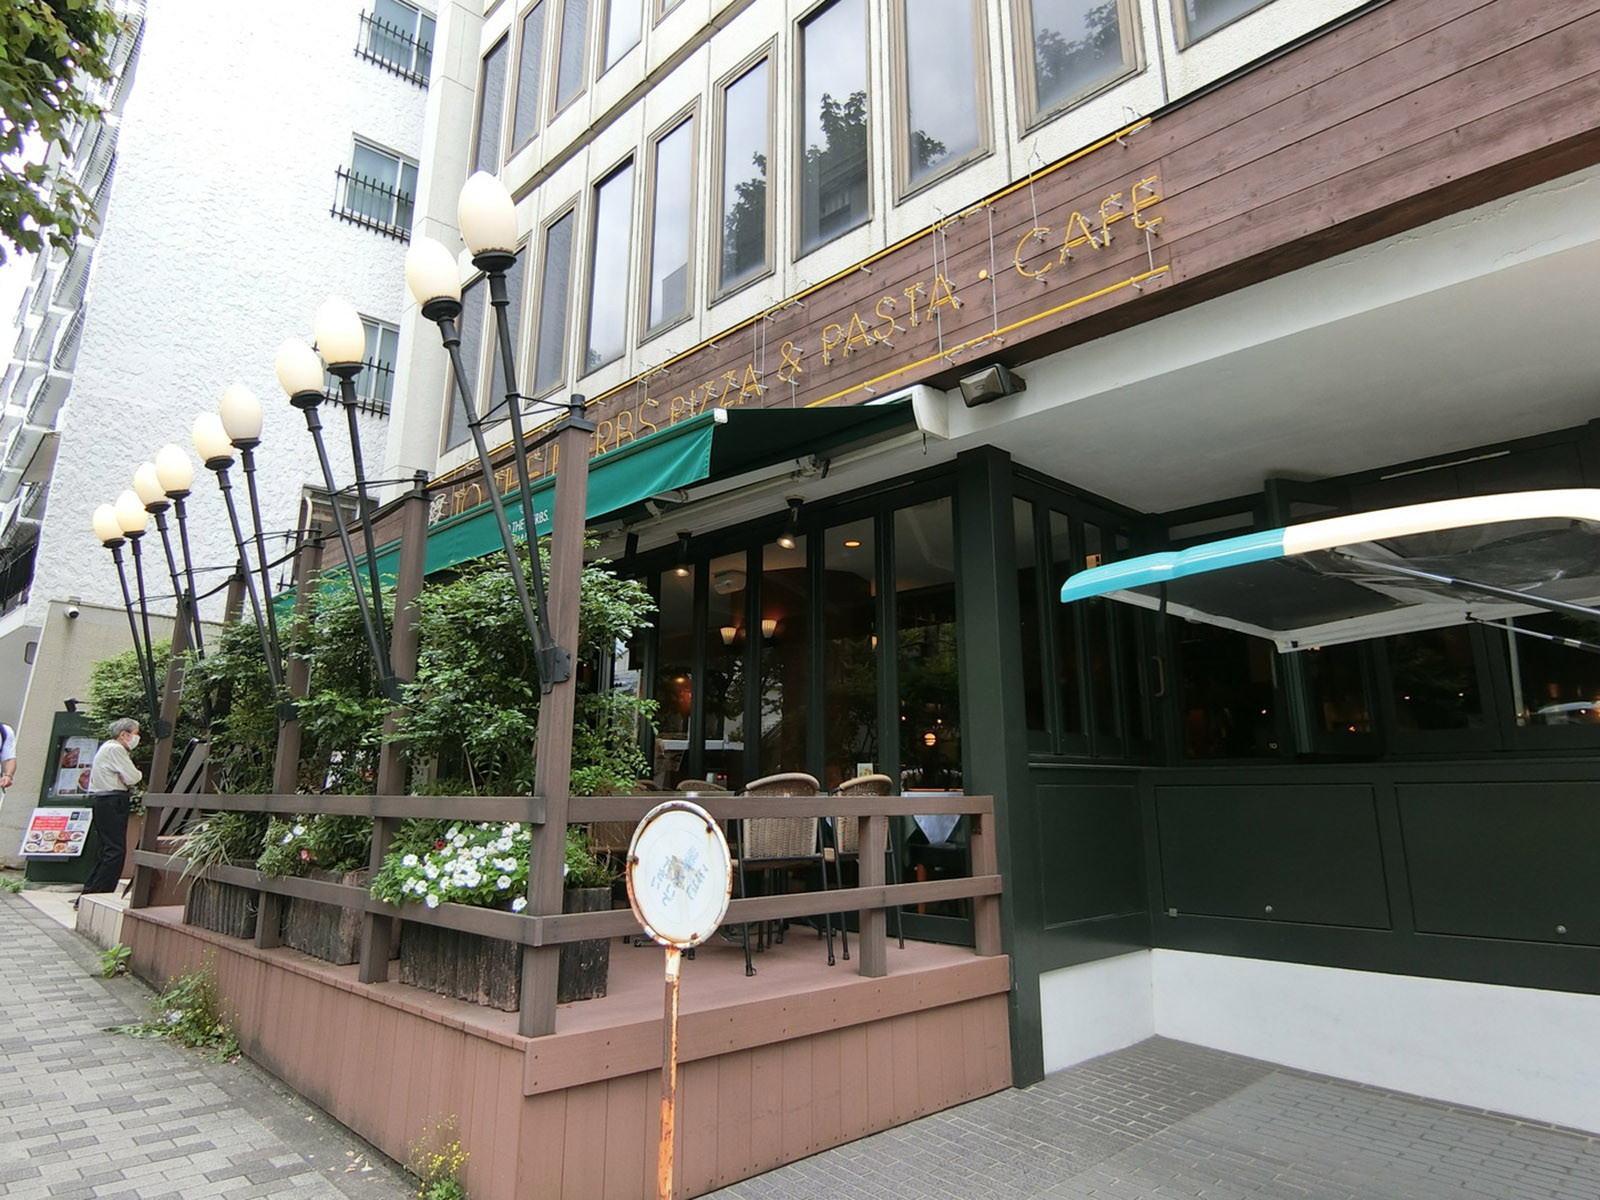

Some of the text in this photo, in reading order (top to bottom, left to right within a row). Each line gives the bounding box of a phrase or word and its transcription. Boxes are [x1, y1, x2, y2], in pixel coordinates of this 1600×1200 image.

[670, 363, 763, 426] PIZZA
[778, 341, 803, 382] &
[823, 274, 959, 366] PASTA
[1014, 175, 1164, 278] CAFE
